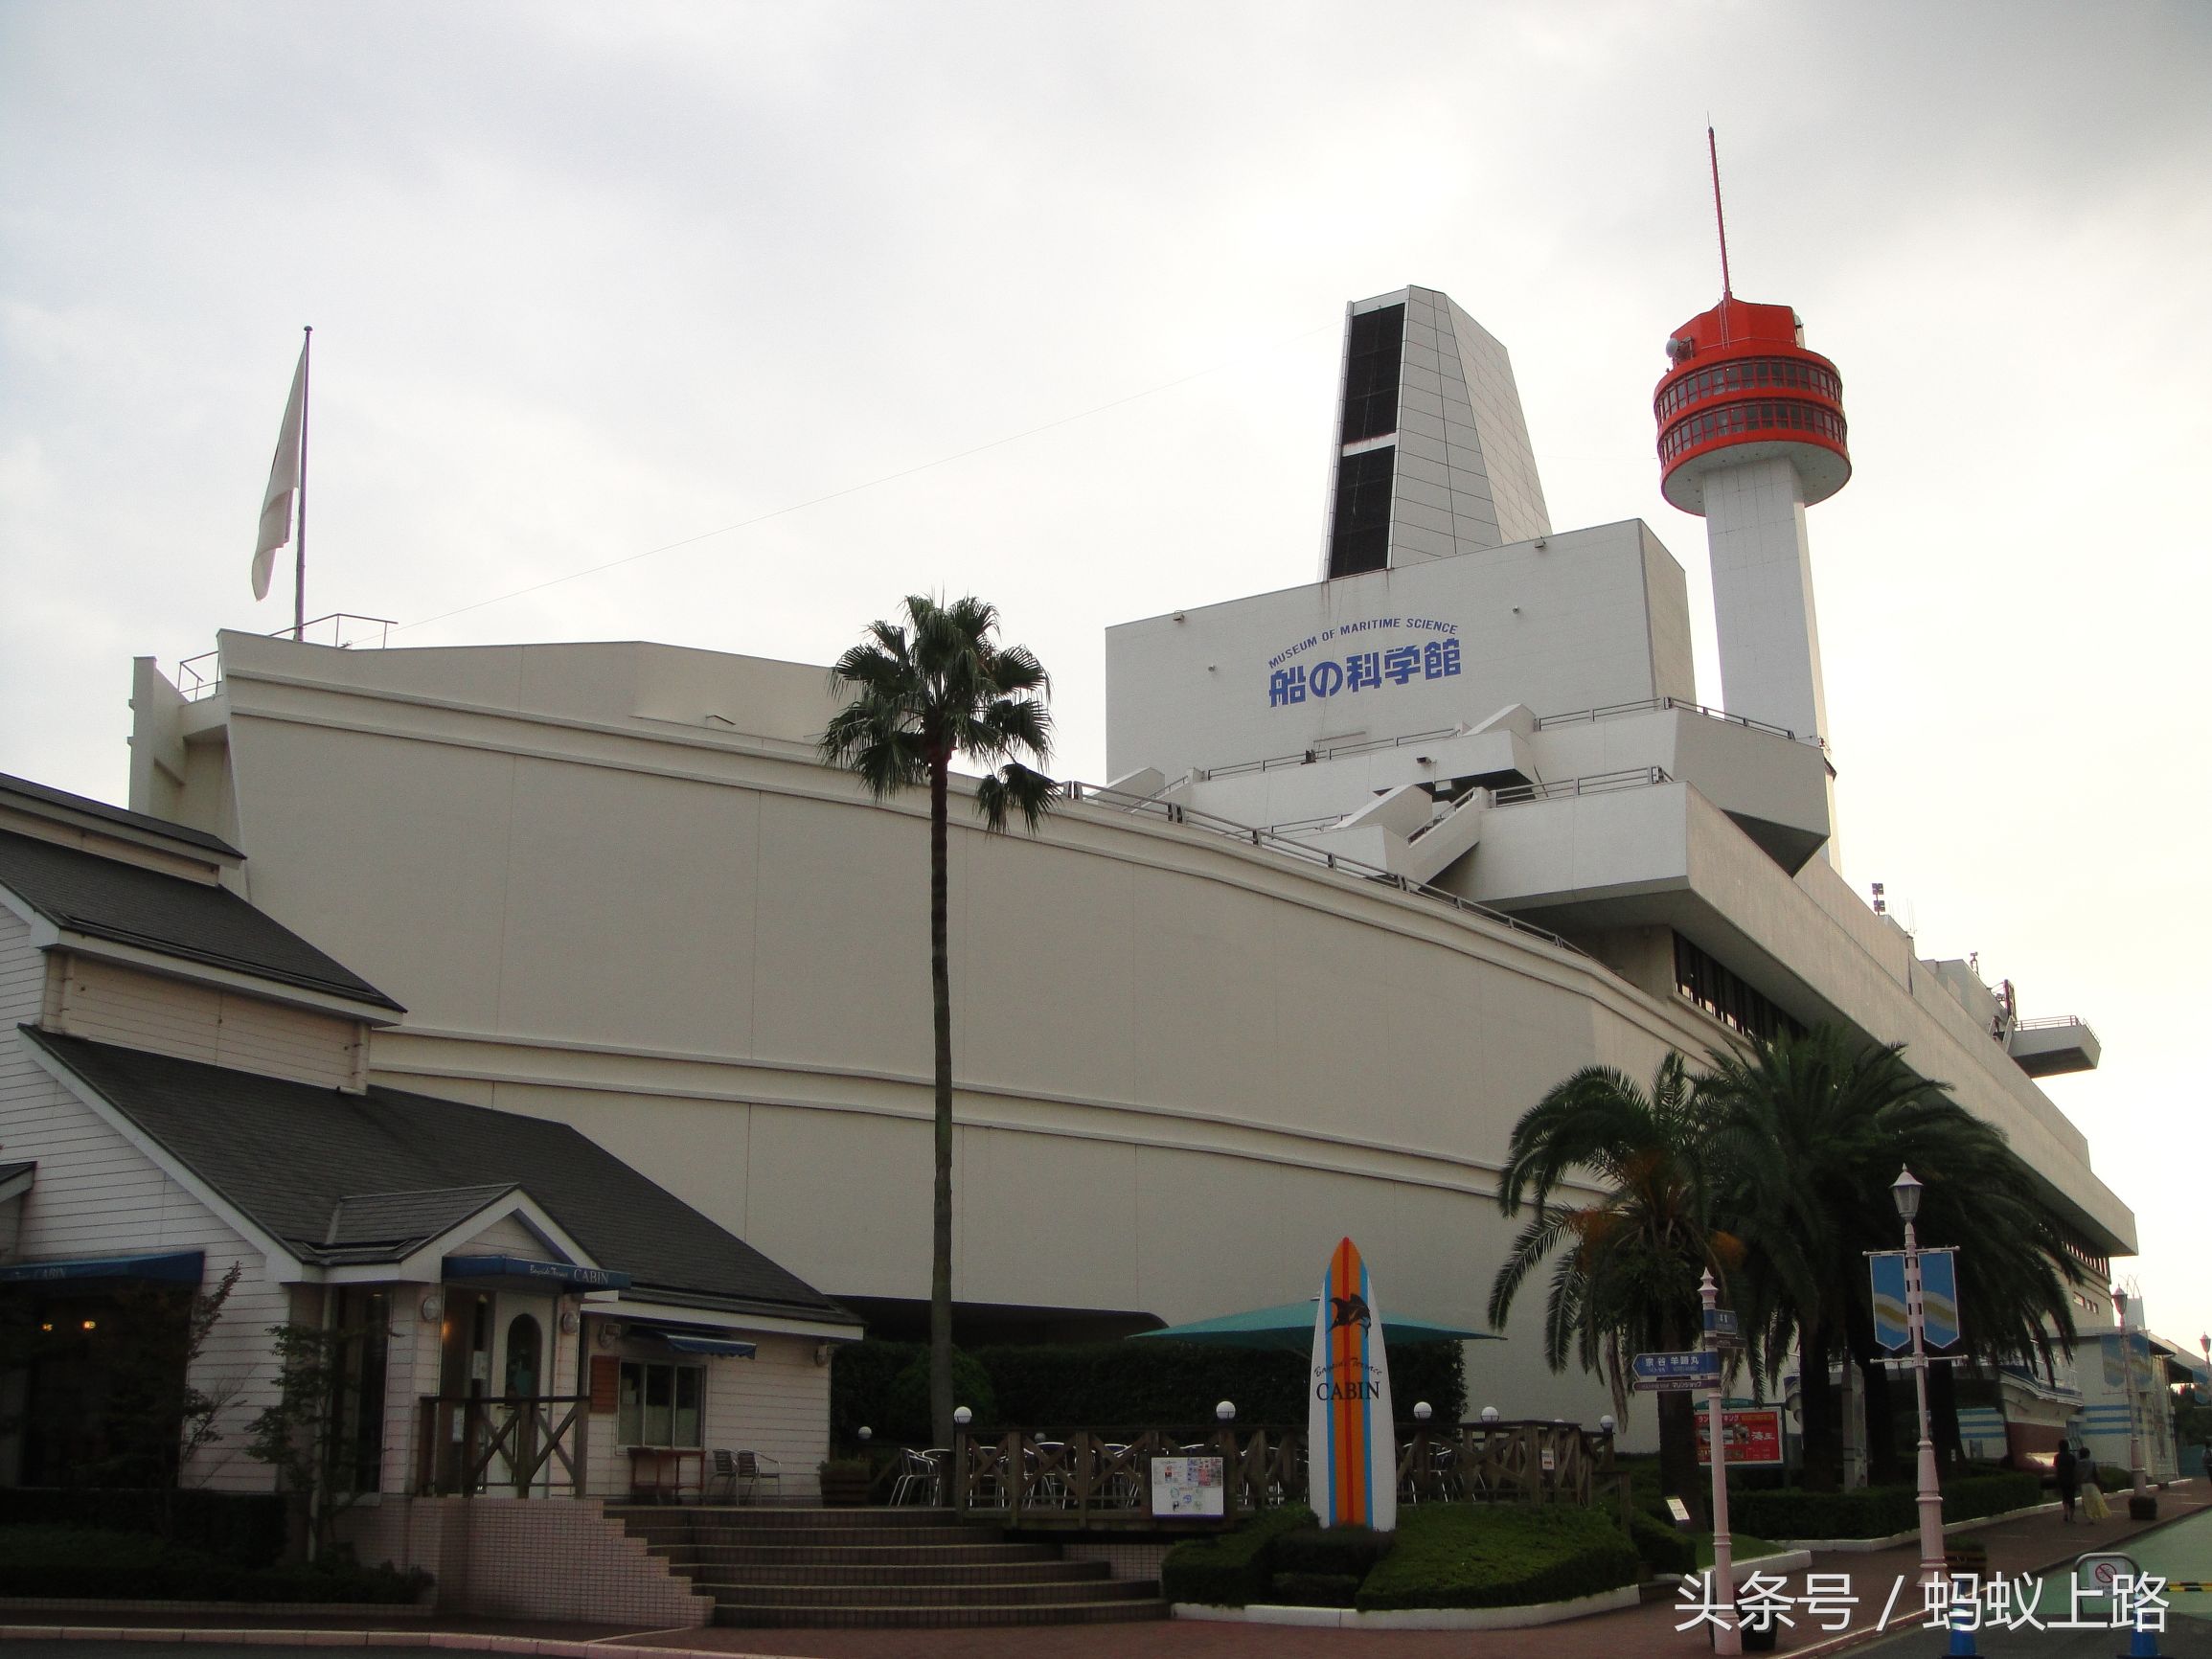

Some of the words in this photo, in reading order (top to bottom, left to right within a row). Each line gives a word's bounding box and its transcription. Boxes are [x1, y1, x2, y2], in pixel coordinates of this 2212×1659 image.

[1267, 636, 1318, 670] MUSEUM
[1322, 628, 1337, 643] OF
[1339, 618, 1402, 636] MARITIME
[1405, 618, 1459, 635] SCIENCE
[1269, 637, 1462, 708] 船の科学館
[574, 1268, 609, 1285] CABIN
[1316, 1381, 1380, 1400] CABIN
